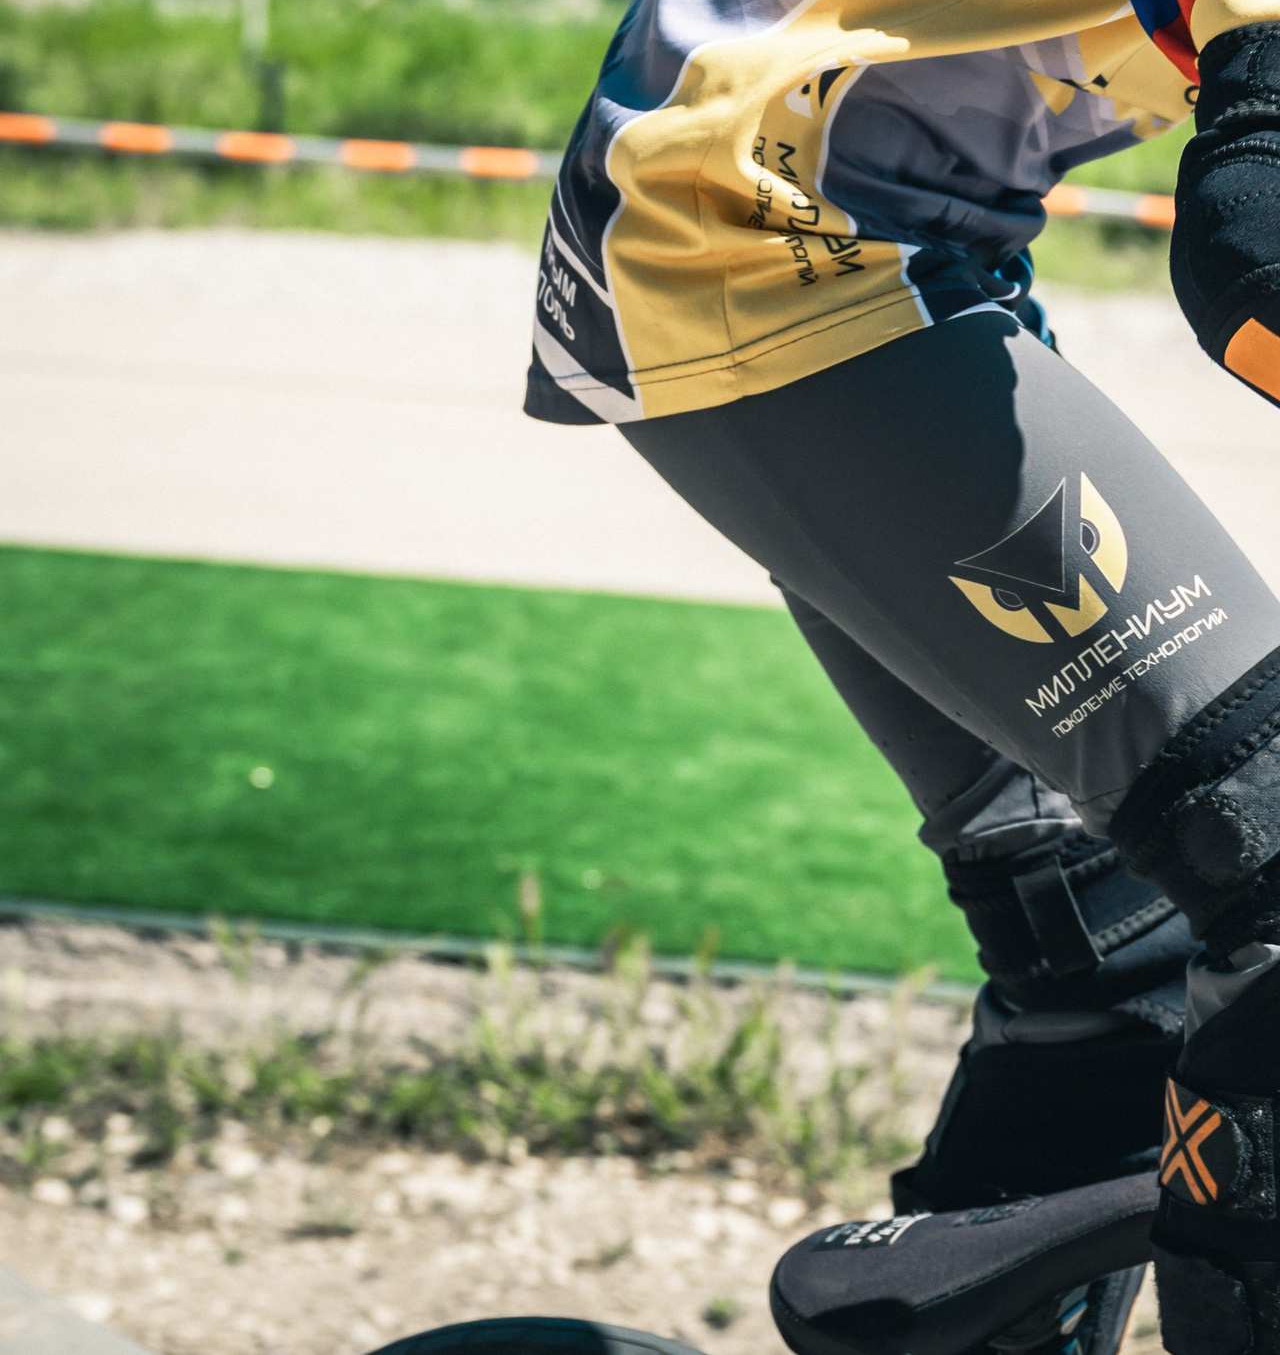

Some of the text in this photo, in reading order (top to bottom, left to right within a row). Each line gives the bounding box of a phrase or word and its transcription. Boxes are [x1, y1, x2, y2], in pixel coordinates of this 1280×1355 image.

[1024, 574, 1212, 718] МИЛЛЕНИУМ
[1051, 607, 1229, 739] ПОКОЛЕНИЕ ТЕХНОЛОГИЙ
